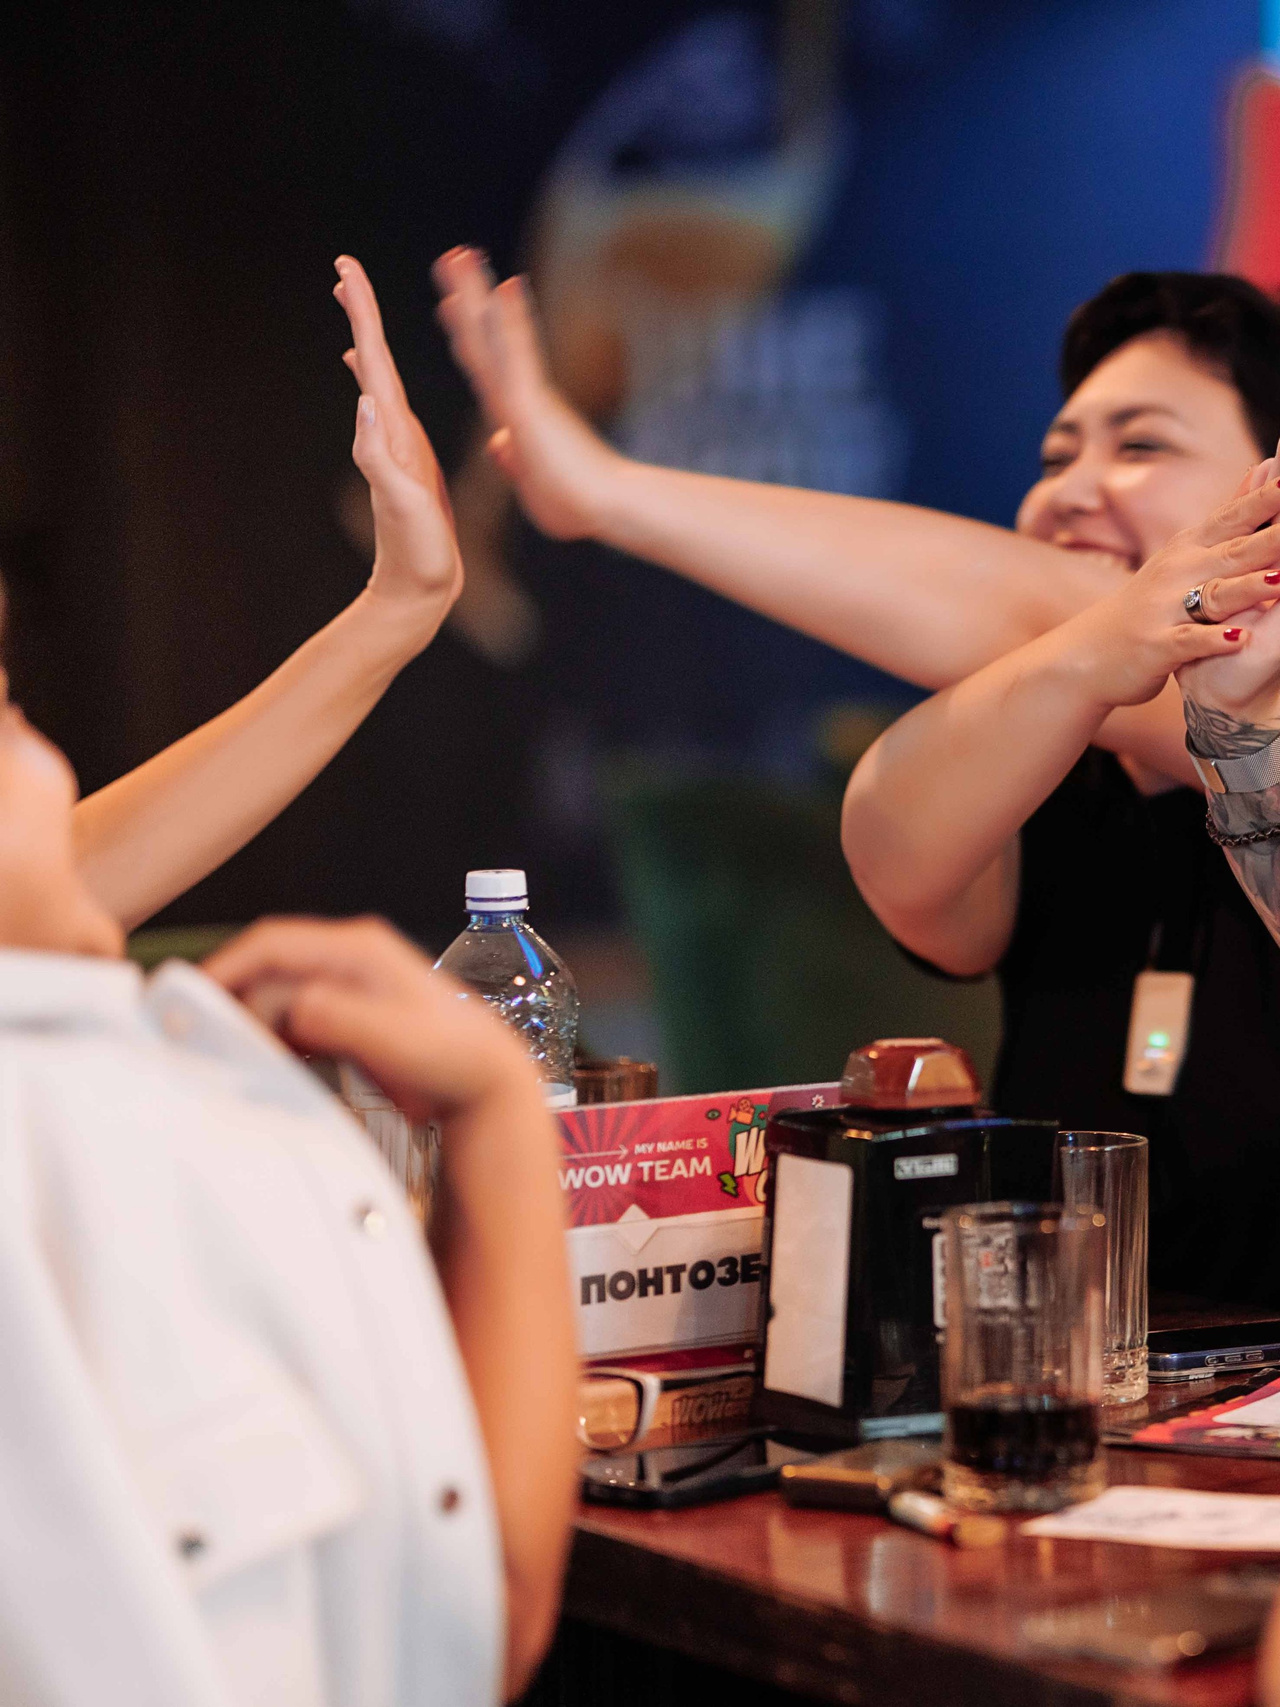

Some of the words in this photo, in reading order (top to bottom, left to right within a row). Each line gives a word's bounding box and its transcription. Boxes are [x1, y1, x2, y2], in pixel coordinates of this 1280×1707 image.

[634, 1143, 655, 1156] MY
[657, 1139, 693, 1153] NAME
[697, 1138, 708, 1149] IS
[558, 1163, 632, 1191] WOW
[637, 1156, 712, 1183] TEAM
